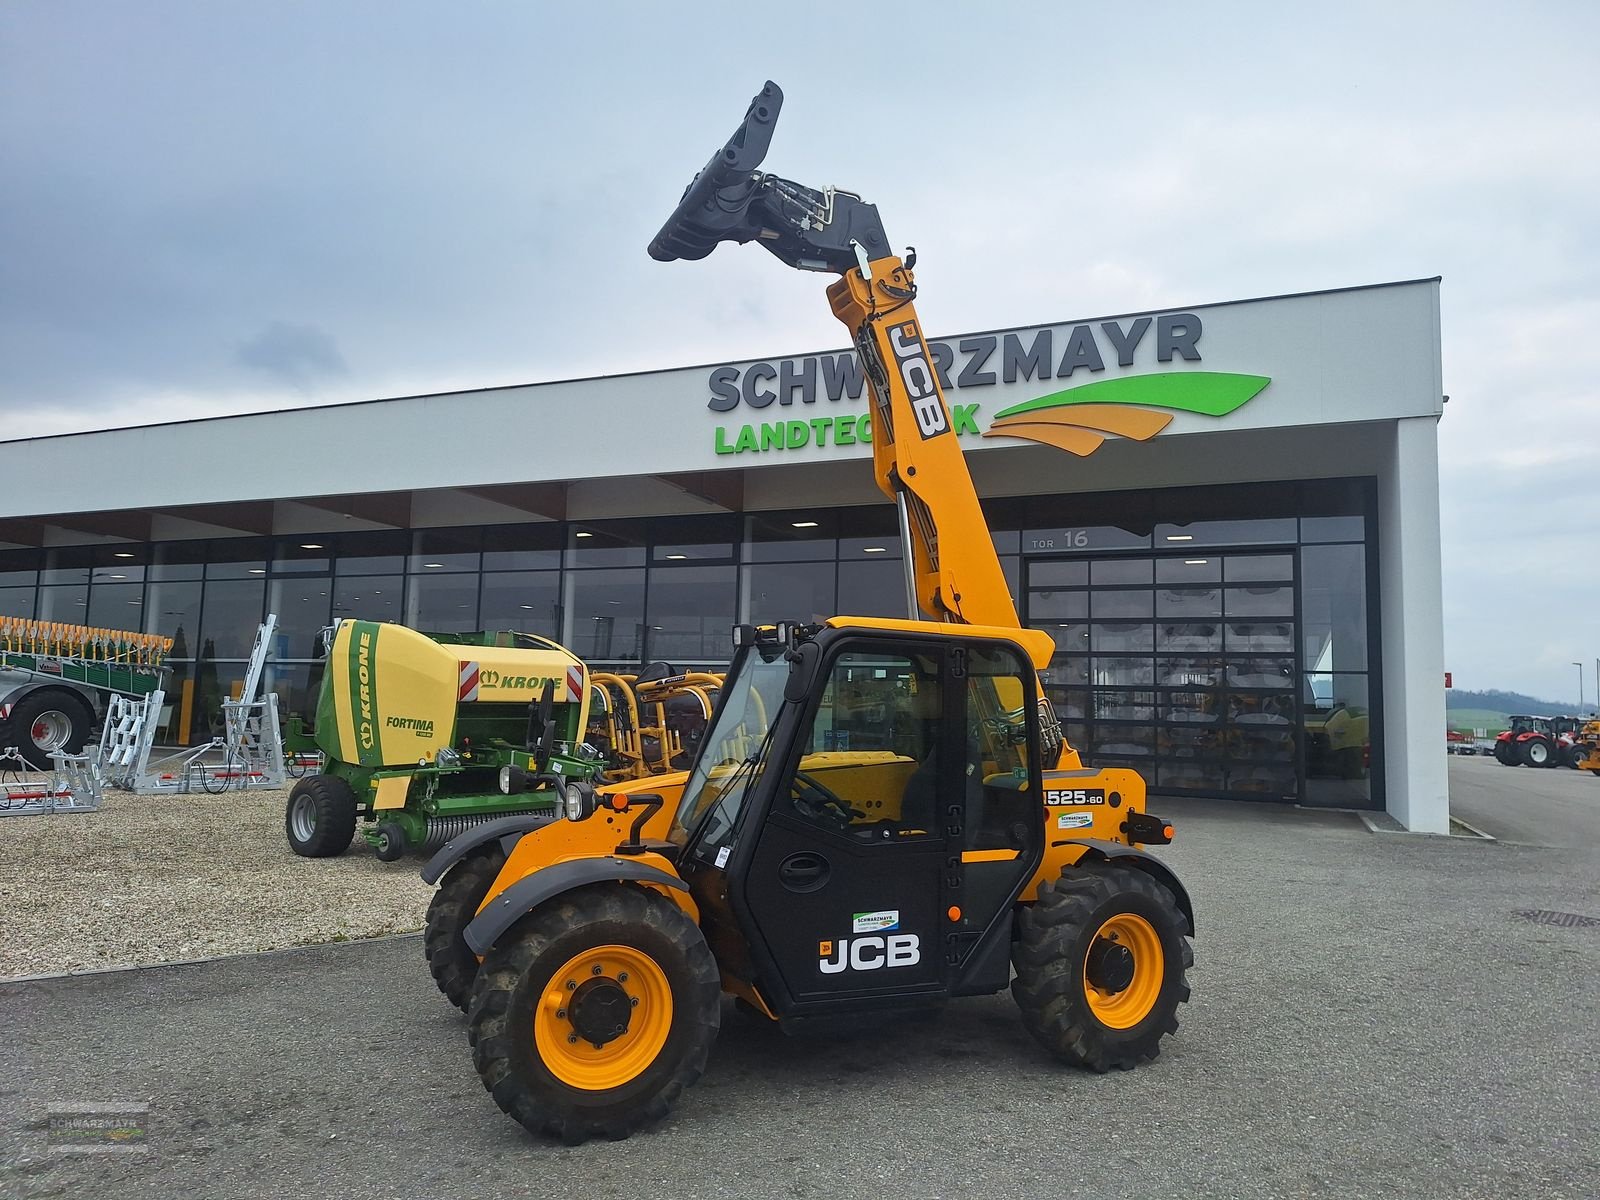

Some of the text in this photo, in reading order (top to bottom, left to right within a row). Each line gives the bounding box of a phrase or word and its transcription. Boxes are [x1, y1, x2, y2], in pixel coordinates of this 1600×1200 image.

[707, 313, 1202, 412] SCHWRZMAYR
[890, 327, 946, 436] JCB
[715, 403, 981, 455] LANDTECK
[1031, 530, 1088, 549] TOR 16
[359, 632, 371, 720] KRONE
[386, 716, 434, 731] FORTIMA
[819, 933, 921, 974] JCB
